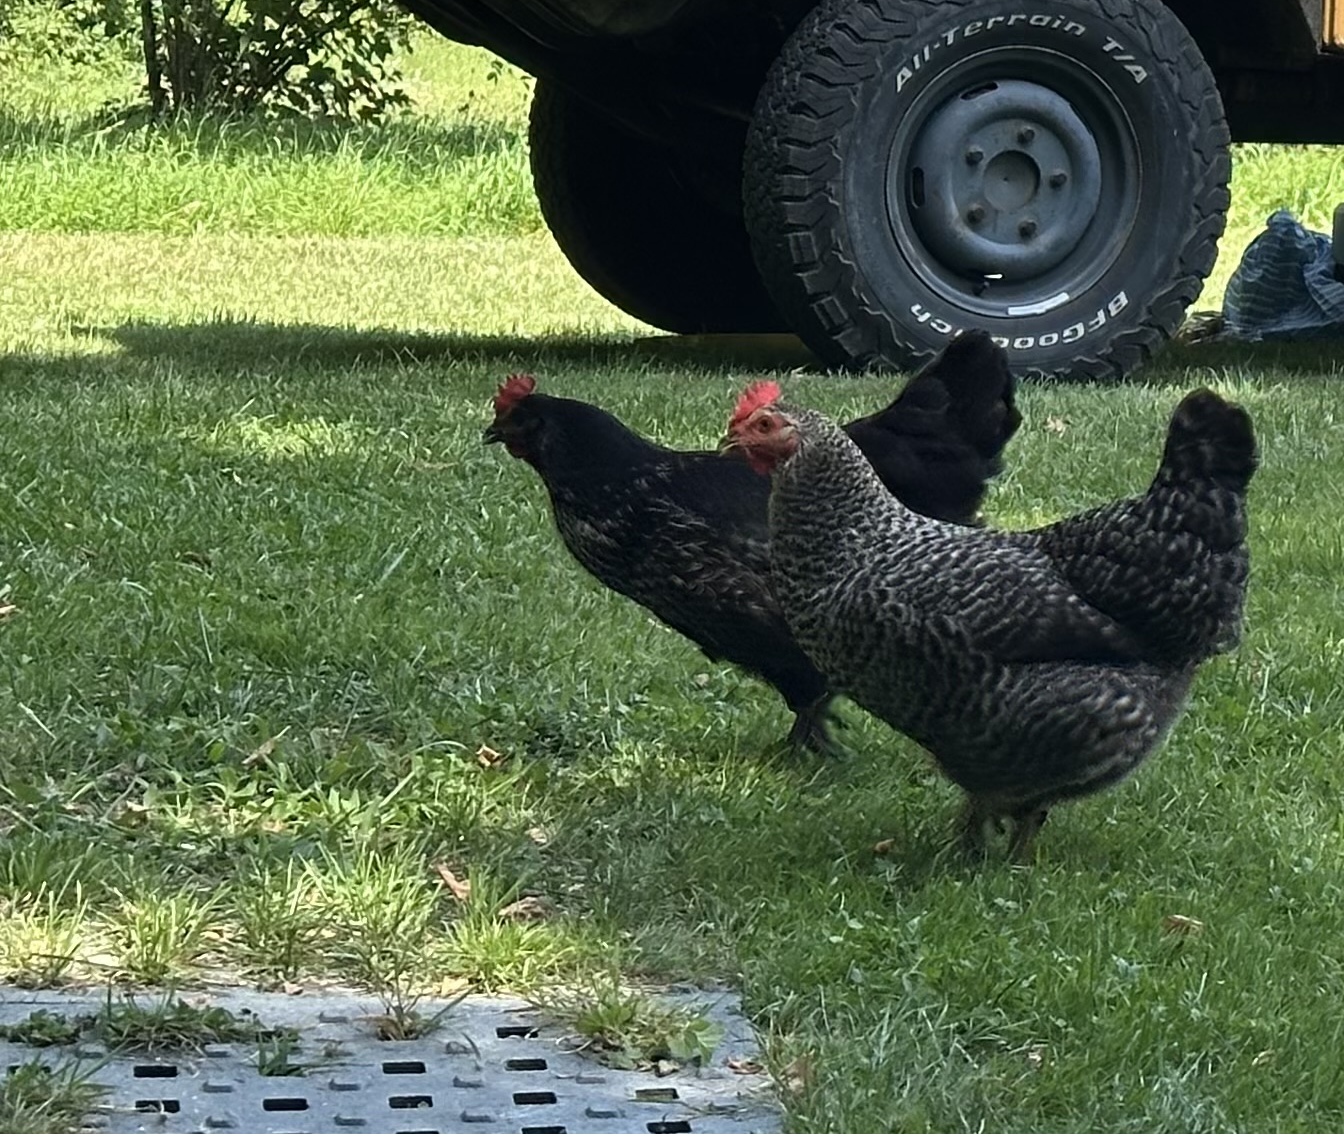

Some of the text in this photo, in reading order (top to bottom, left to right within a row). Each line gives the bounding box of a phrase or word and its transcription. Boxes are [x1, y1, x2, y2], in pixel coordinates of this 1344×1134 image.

[896, 13, 1149, 94] All-Terrain T/A
[909, 290, 1129, 350] BFGooich
